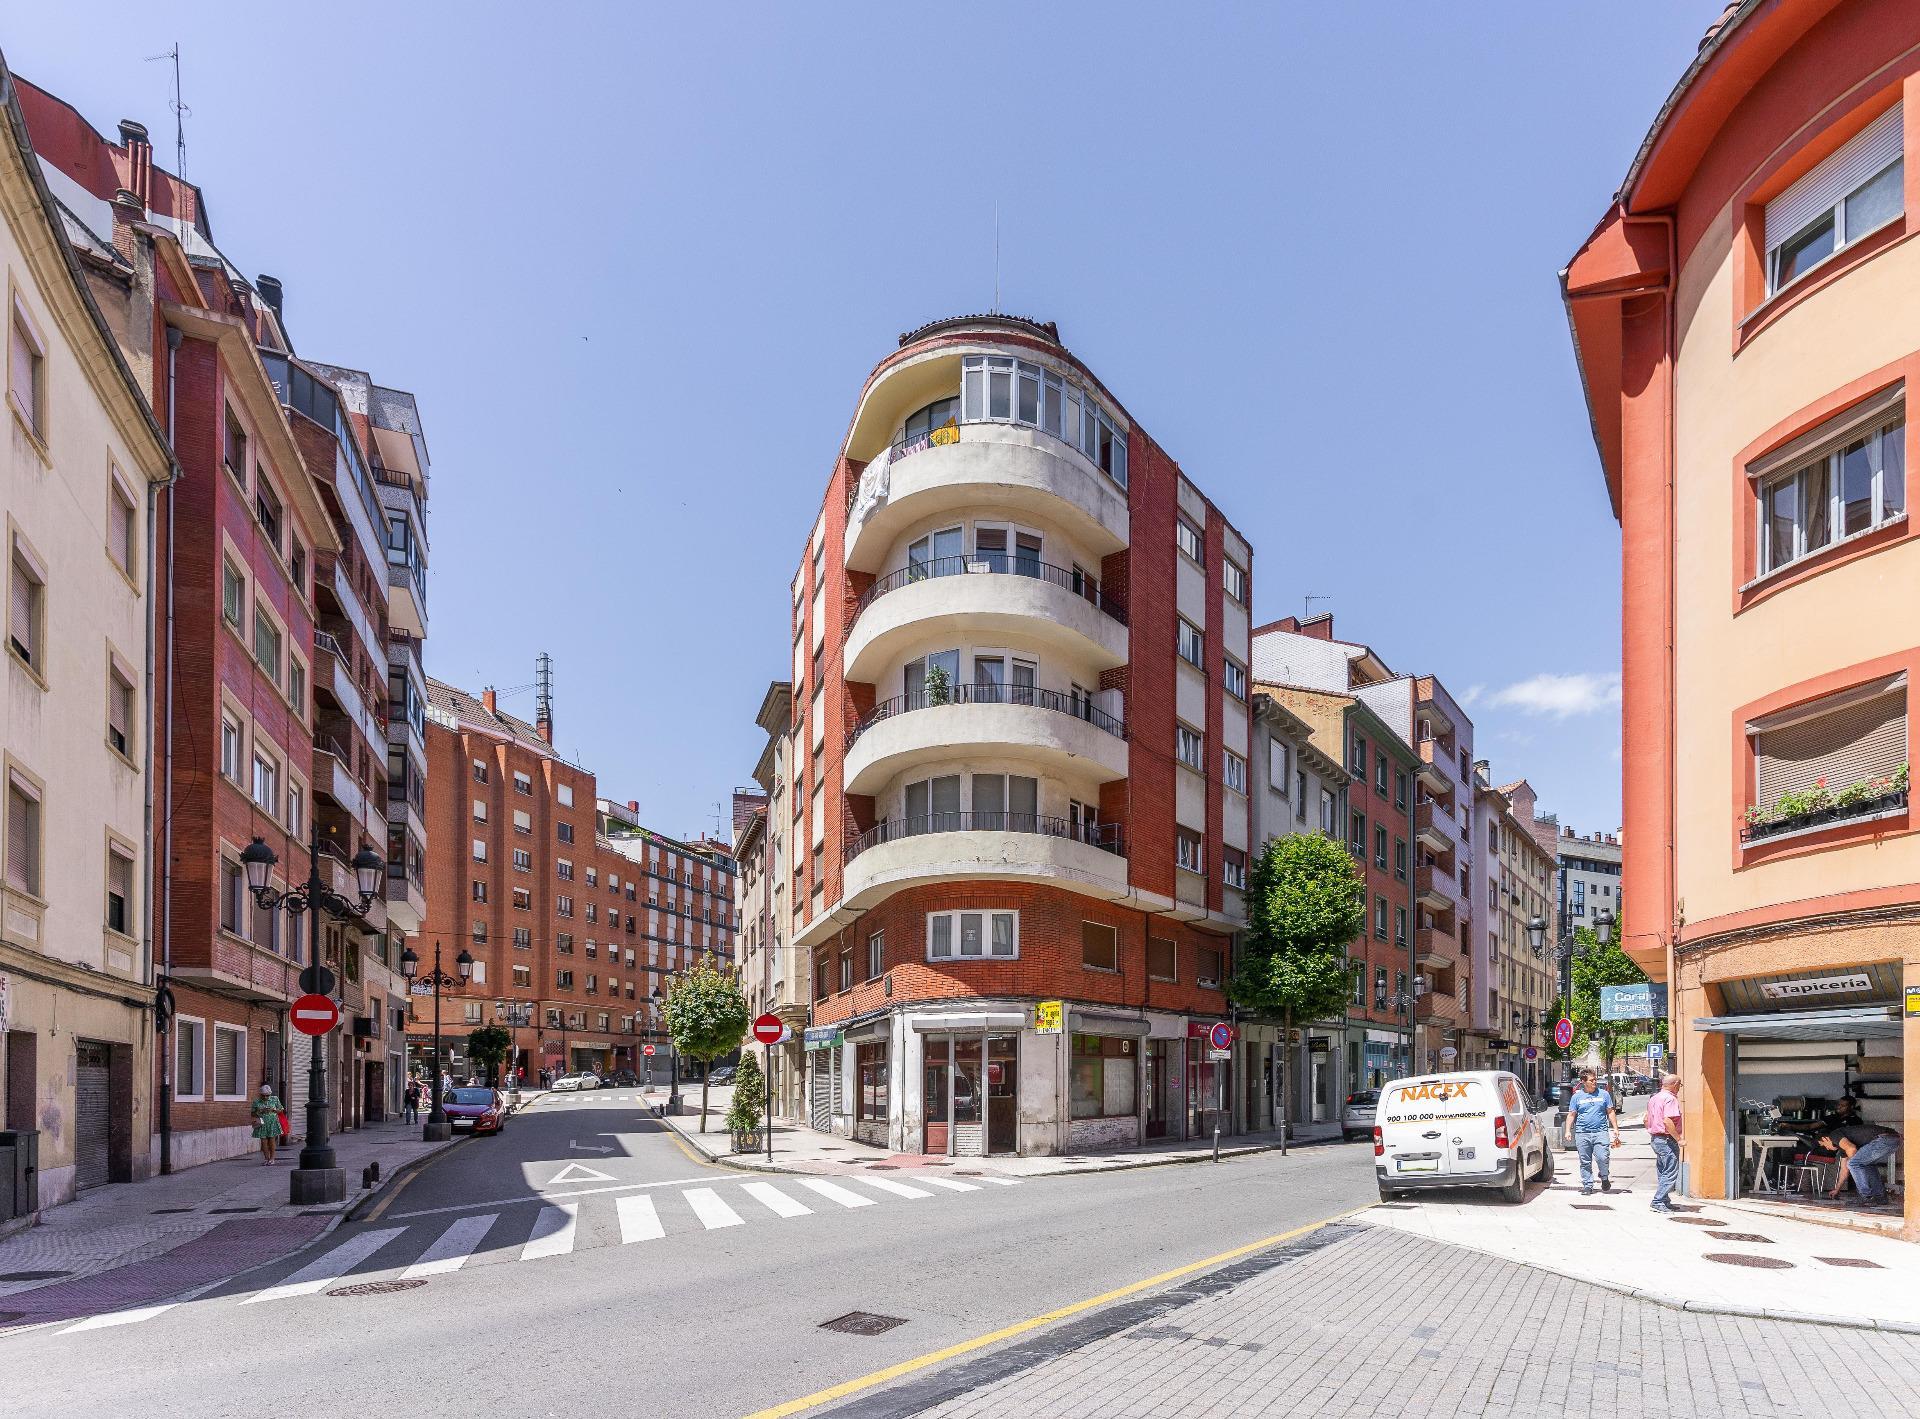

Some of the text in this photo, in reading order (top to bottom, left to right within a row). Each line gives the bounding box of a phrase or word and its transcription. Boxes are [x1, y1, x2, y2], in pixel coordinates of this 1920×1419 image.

[1778, 979, 1867, 993] Tapicería
[1650, 1045, 1660, 1057] P
[1400, 1082, 1470, 1102] NACEX
[1435, 1111, 1486, 1119] www.nacex.es
